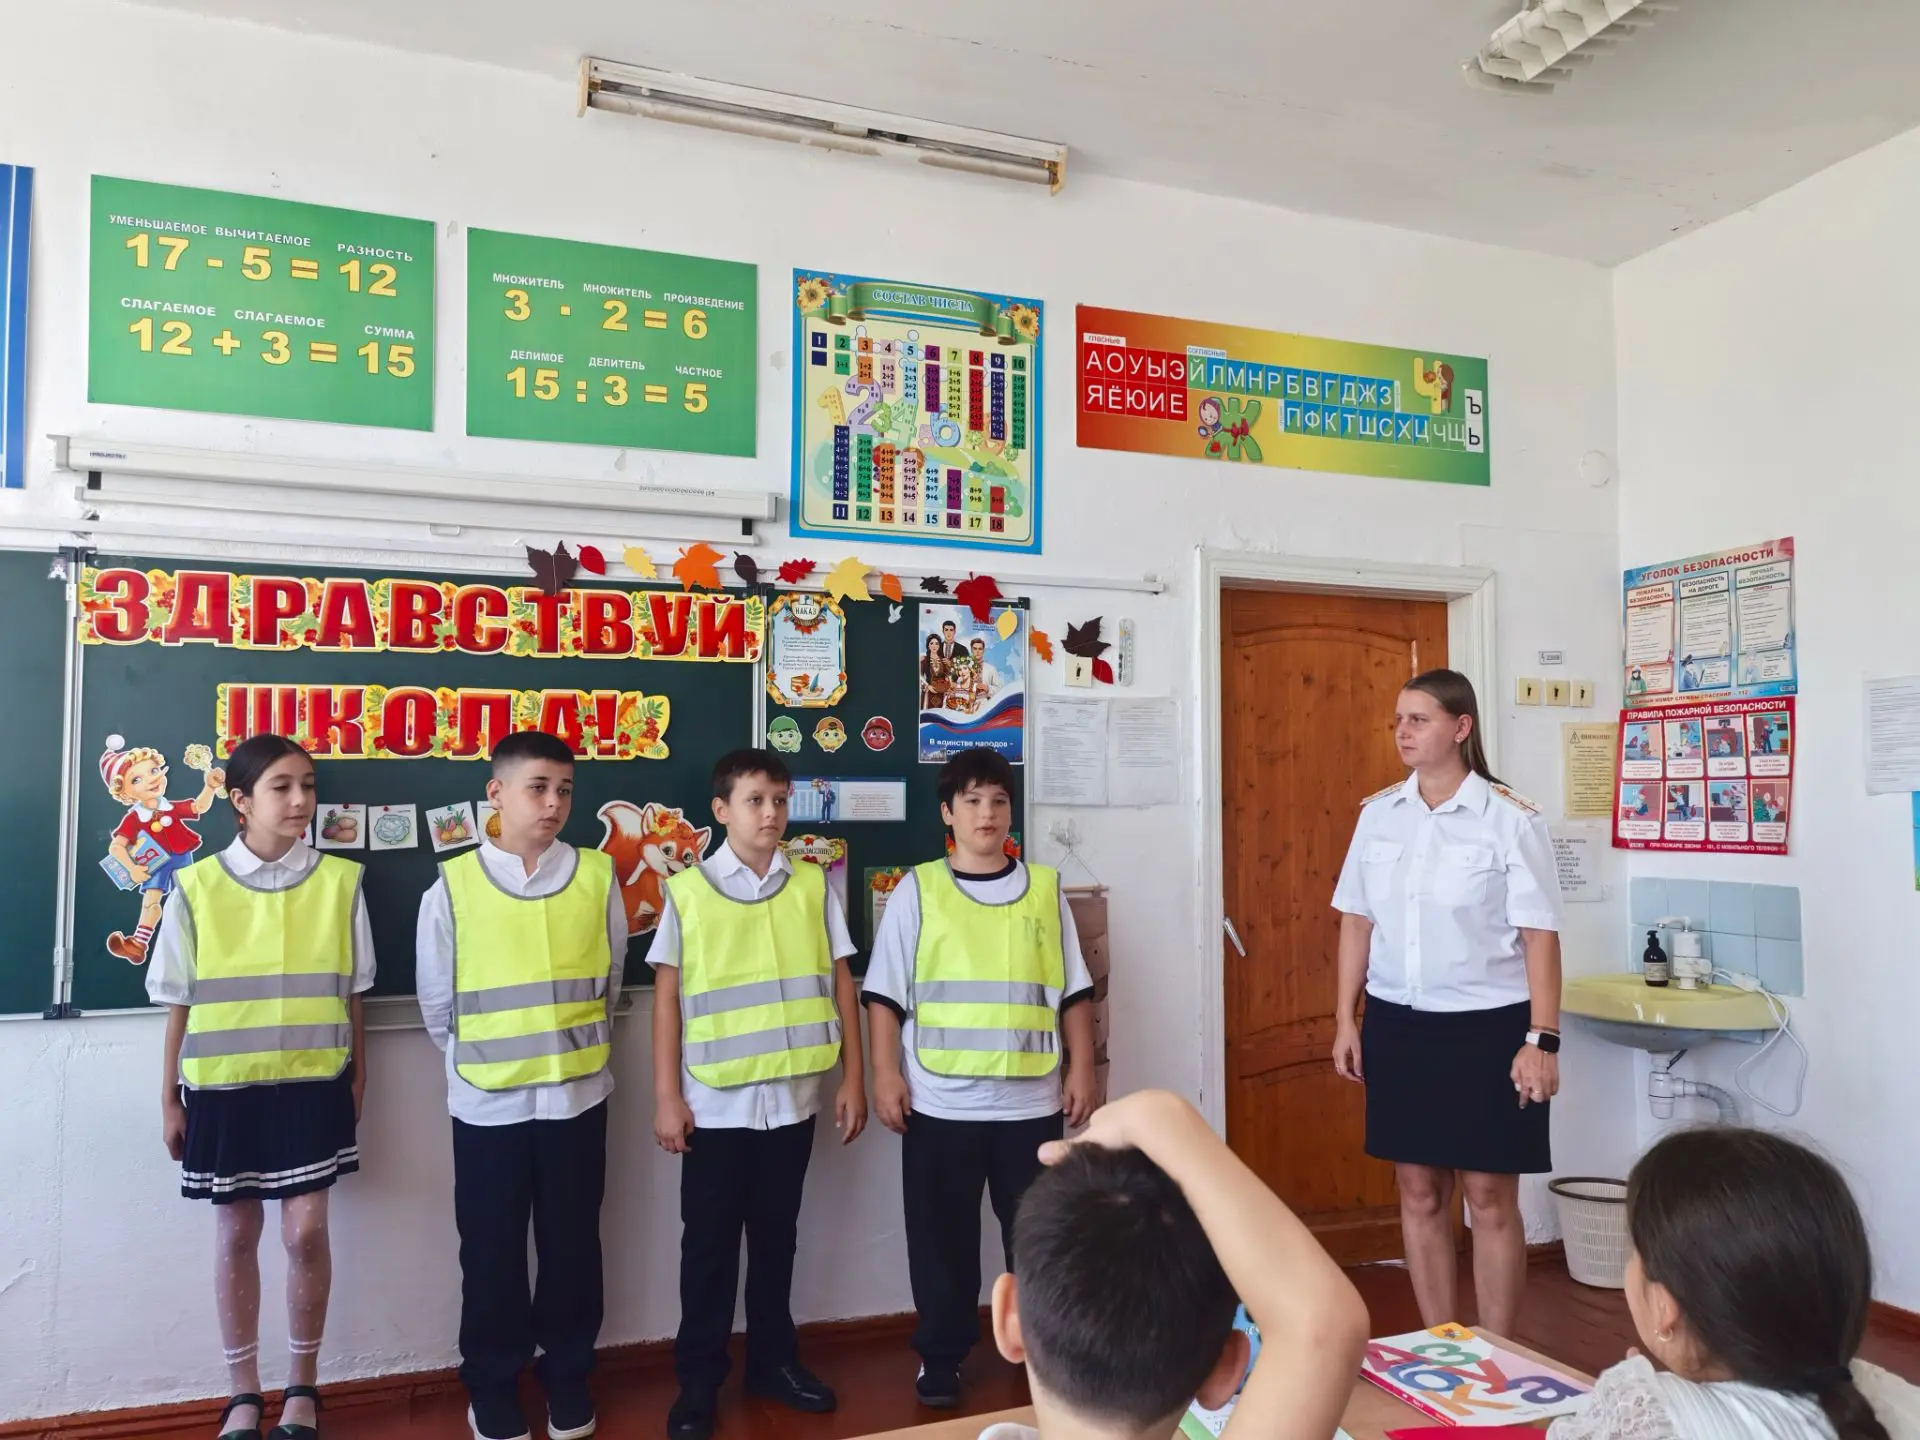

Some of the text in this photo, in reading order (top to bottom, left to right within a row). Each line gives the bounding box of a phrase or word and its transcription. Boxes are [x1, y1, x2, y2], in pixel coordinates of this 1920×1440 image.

[109, 214, 414, 262] УМЕНЬШАЕМОЕ ВЫЧИТАЕМОЕ РАЗНОСТЬ
[125, 233, 191, 272] 17
[241, 246, 272, 281] 5
[338, 259, 398, 297] 12
[493, 272, 744, 311] МНОЖИТЕЛЬ МНОЖИТЕЛЬ ПРОИЗВЕДЕНИЕ
[872, 288, 975, 312] СОСТАВ ЧИСЛА
[120, 297, 415, 340] СЛАГАЕМОЕ СЛАГАЕМОЕ СУММА
[504, 289, 531, 322] 3
[602, 299, 628, 332] 2
[682, 309, 708, 340] 6
[128, 317, 194, 356] 12
[260, 330, 291, 366] 3
[357, 341, 415, 379] 15
[510, 350, 722, 379] ДЕЛИМОЕ ДЕЛИТЕЛЬ ЧАСТНОЕ
[839, 338, 846, 348] 2
[861, 340, 869, 351] 3
[884, 343, 892, 353] 4
[907, 345, 914, 356] 5
[951, 350, 958, 360] 7
[995, 357, 1001, 366] 9
[1013, 359, 1024, 369] 10
[505, 366, 561, 401] 15
[603, 374, 629, 407] 3
[683, 383, 708, 414] 5
[835, 507, 1003, 530] 11 12 13 14 15 16 17 18
[1641, 547, 1774, 581] УГОЛОК БЕЗОПАСНОСТИ
[1682, 575, 1725, 588] БЕЗОПАСНОСТЬ
[93, 569, 759, 660] ЗДРАВСТВУЙ,
[795, 606, 817, 616] НАКАЗ
[226, 684, 621, 758] ШКОЛА!
[1627, 700, 1786, 720] ПРАВИЛА ПОЖАРНОЙ БЕЗОПАСНОСТИ
